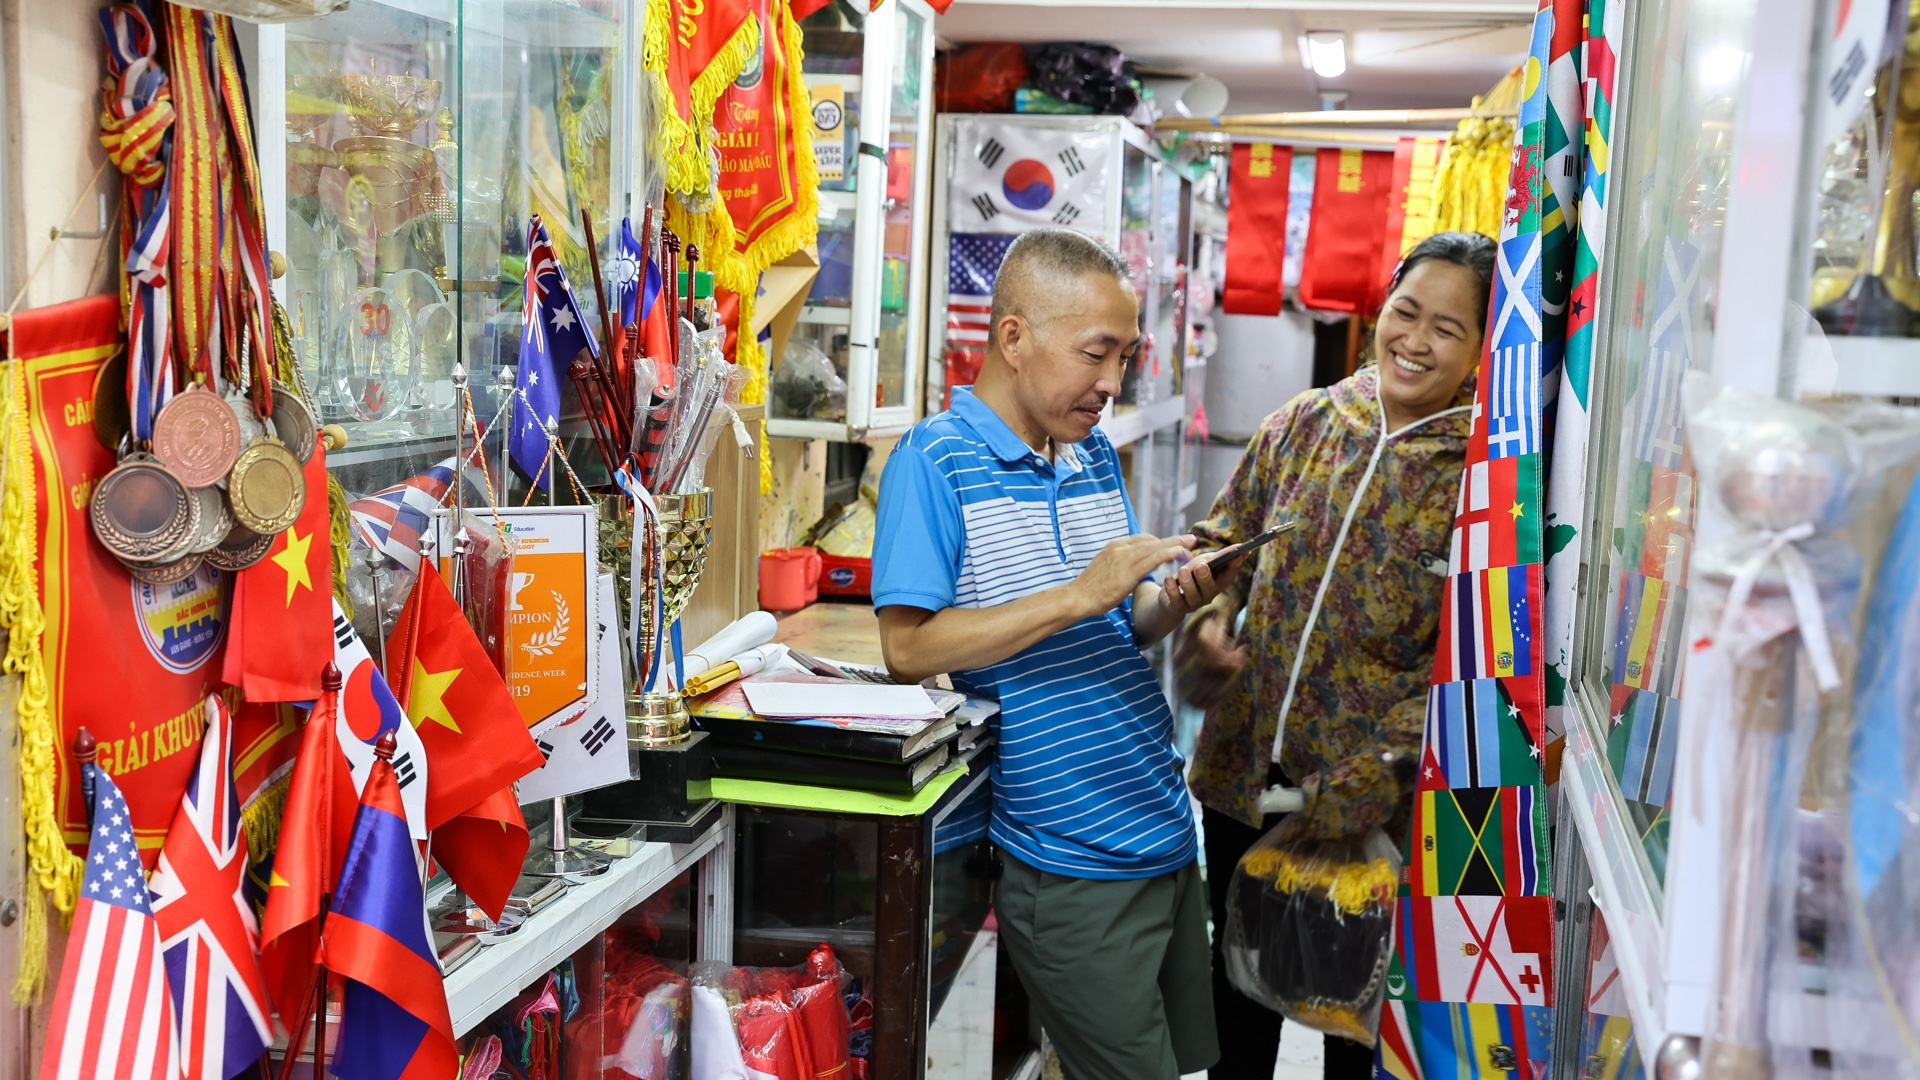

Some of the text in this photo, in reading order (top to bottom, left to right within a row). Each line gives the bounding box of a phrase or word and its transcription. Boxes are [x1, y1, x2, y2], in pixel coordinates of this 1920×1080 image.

[716, 127, 752, 148] GIẢI
[360, 303, 390, 336] 30
[510, 612, 552, 624] MPION
[543, 669, 566, 677] WEEK
[95, 720, 149, 776] GIẢI
